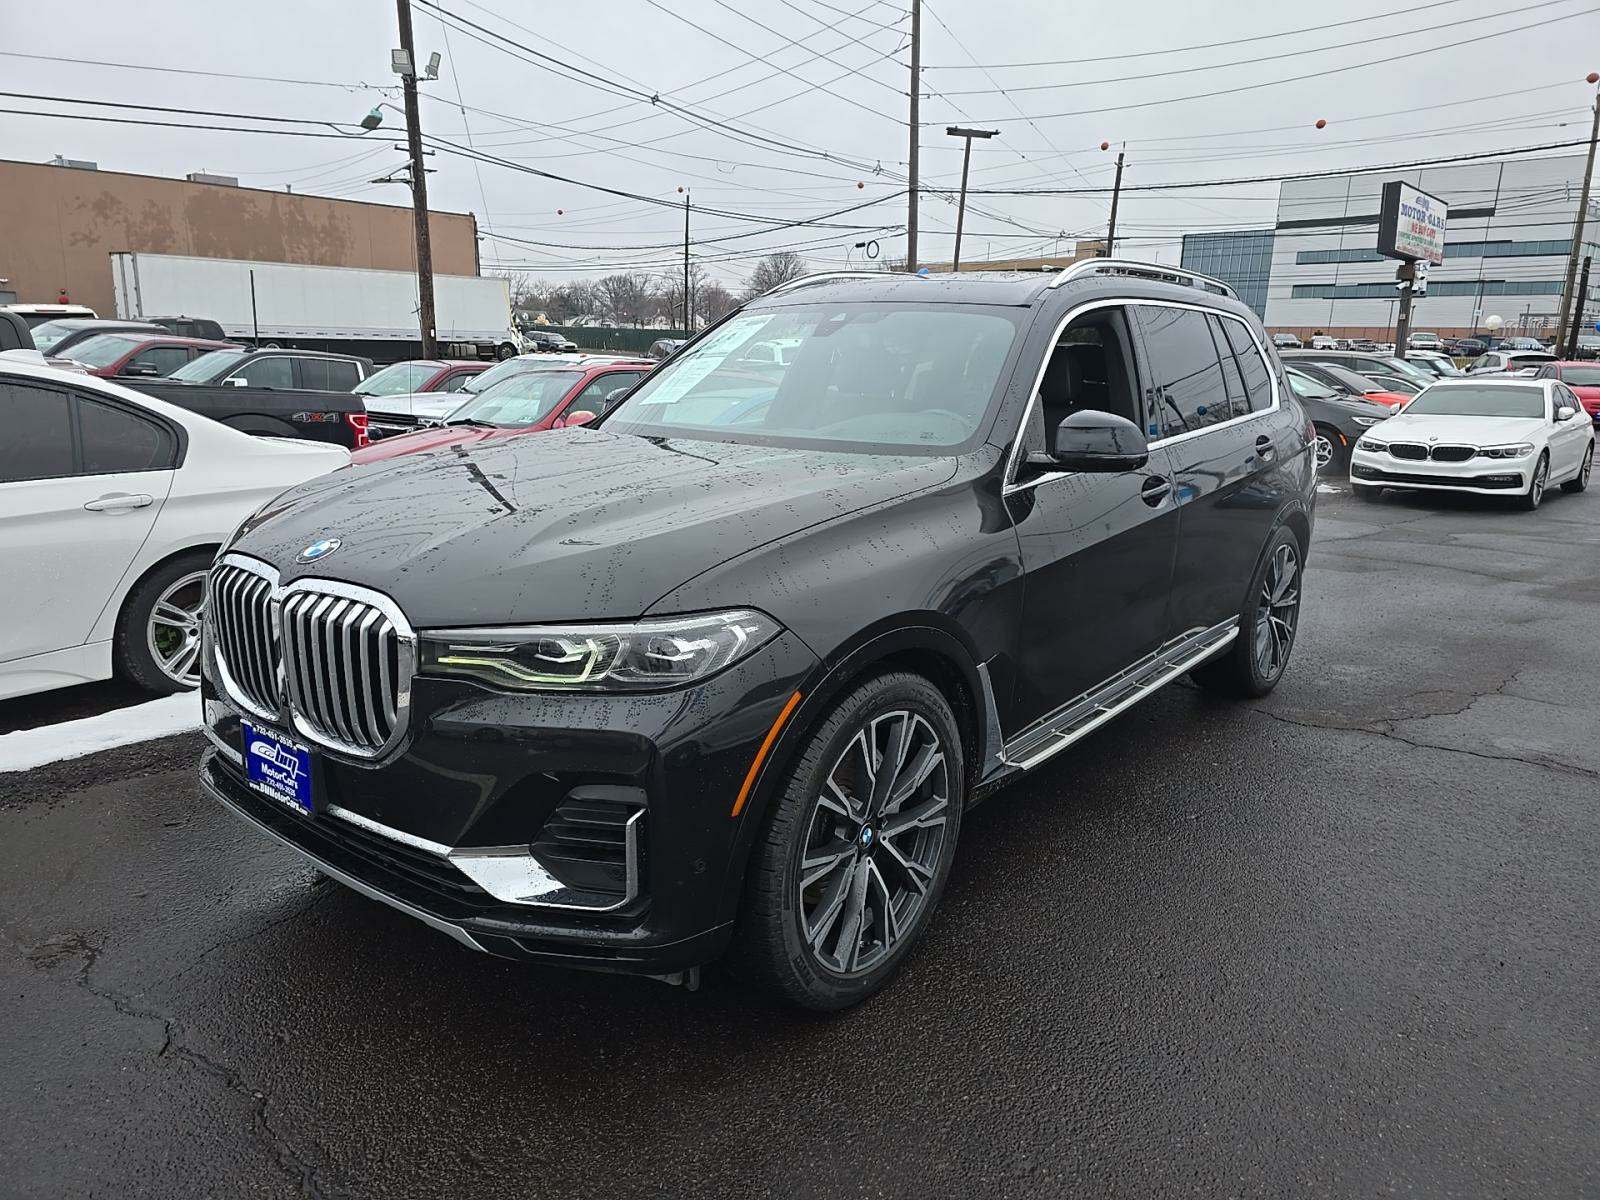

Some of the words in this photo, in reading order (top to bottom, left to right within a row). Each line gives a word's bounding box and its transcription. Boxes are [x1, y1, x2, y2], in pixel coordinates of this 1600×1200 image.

[1401, 203, 1426, 222] MOTOR
[1428, 213, 1445, 230] CARS
[261, 761, 299, 790] MotorCars
